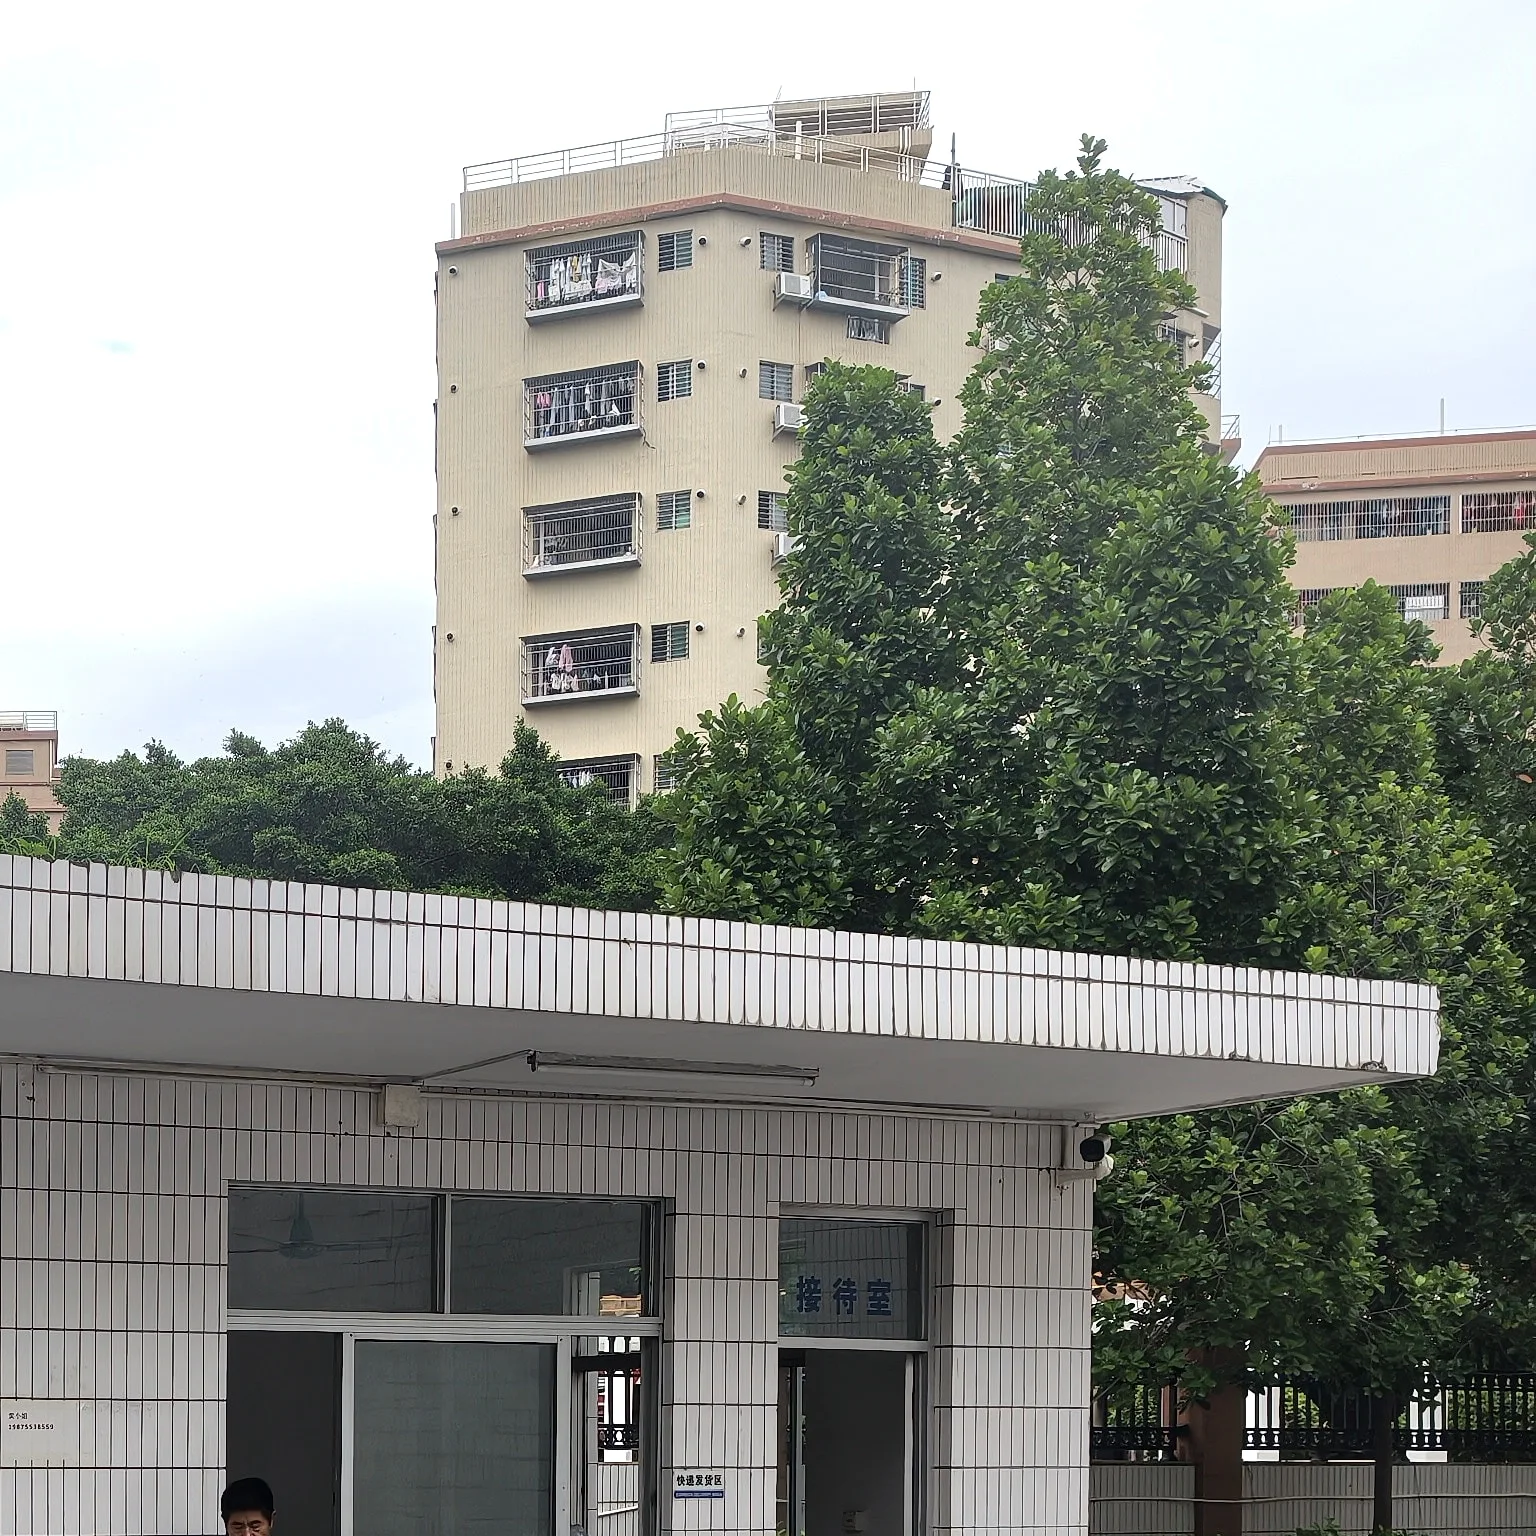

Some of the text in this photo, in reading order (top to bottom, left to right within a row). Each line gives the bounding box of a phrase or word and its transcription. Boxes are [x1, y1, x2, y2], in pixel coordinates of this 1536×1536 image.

[796, 1275, 892, 1316] 接待室
[676, 1474, 723, 1487] 快递发货区
